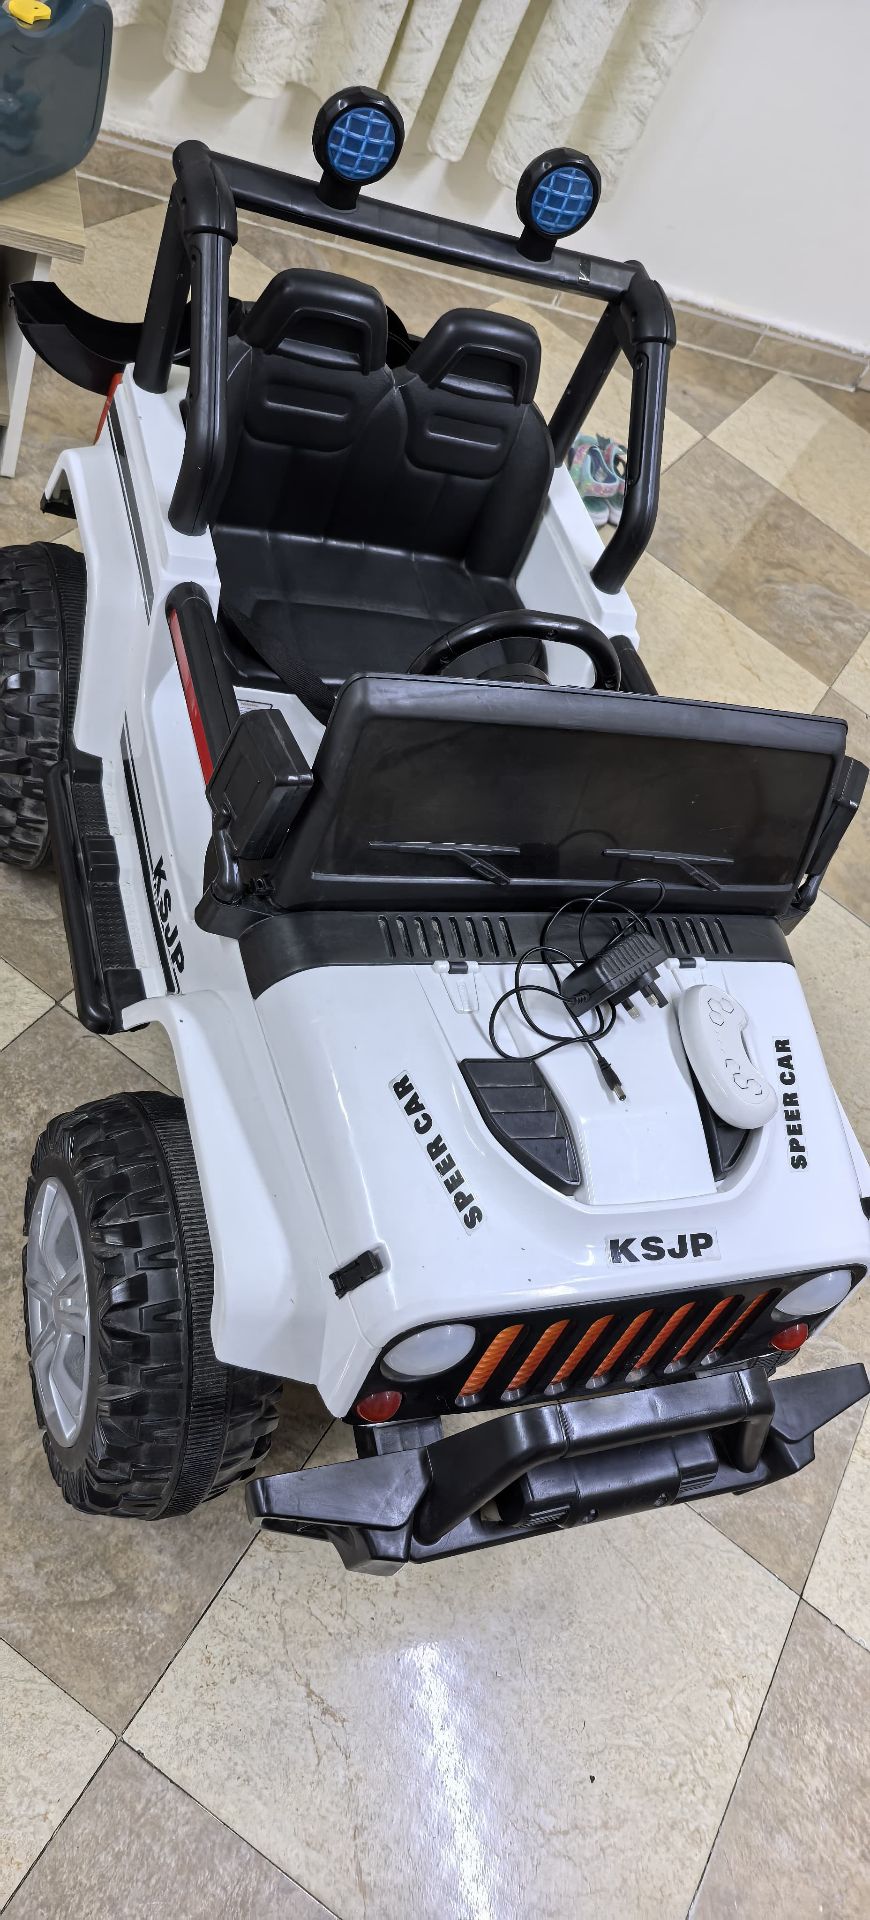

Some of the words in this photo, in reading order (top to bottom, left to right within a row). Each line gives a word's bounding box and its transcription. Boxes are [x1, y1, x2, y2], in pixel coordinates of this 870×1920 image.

[153, 854, 185, 974] KSJP
[774, 1039, 796, 1086] CAR
[392, 1074, 433, 1135] CAR
[782, 1092, 808, 1170] SPEER
[426, 1133, 483, 1230] SPEER
[609, 1232, 714, 1264] KSJP
